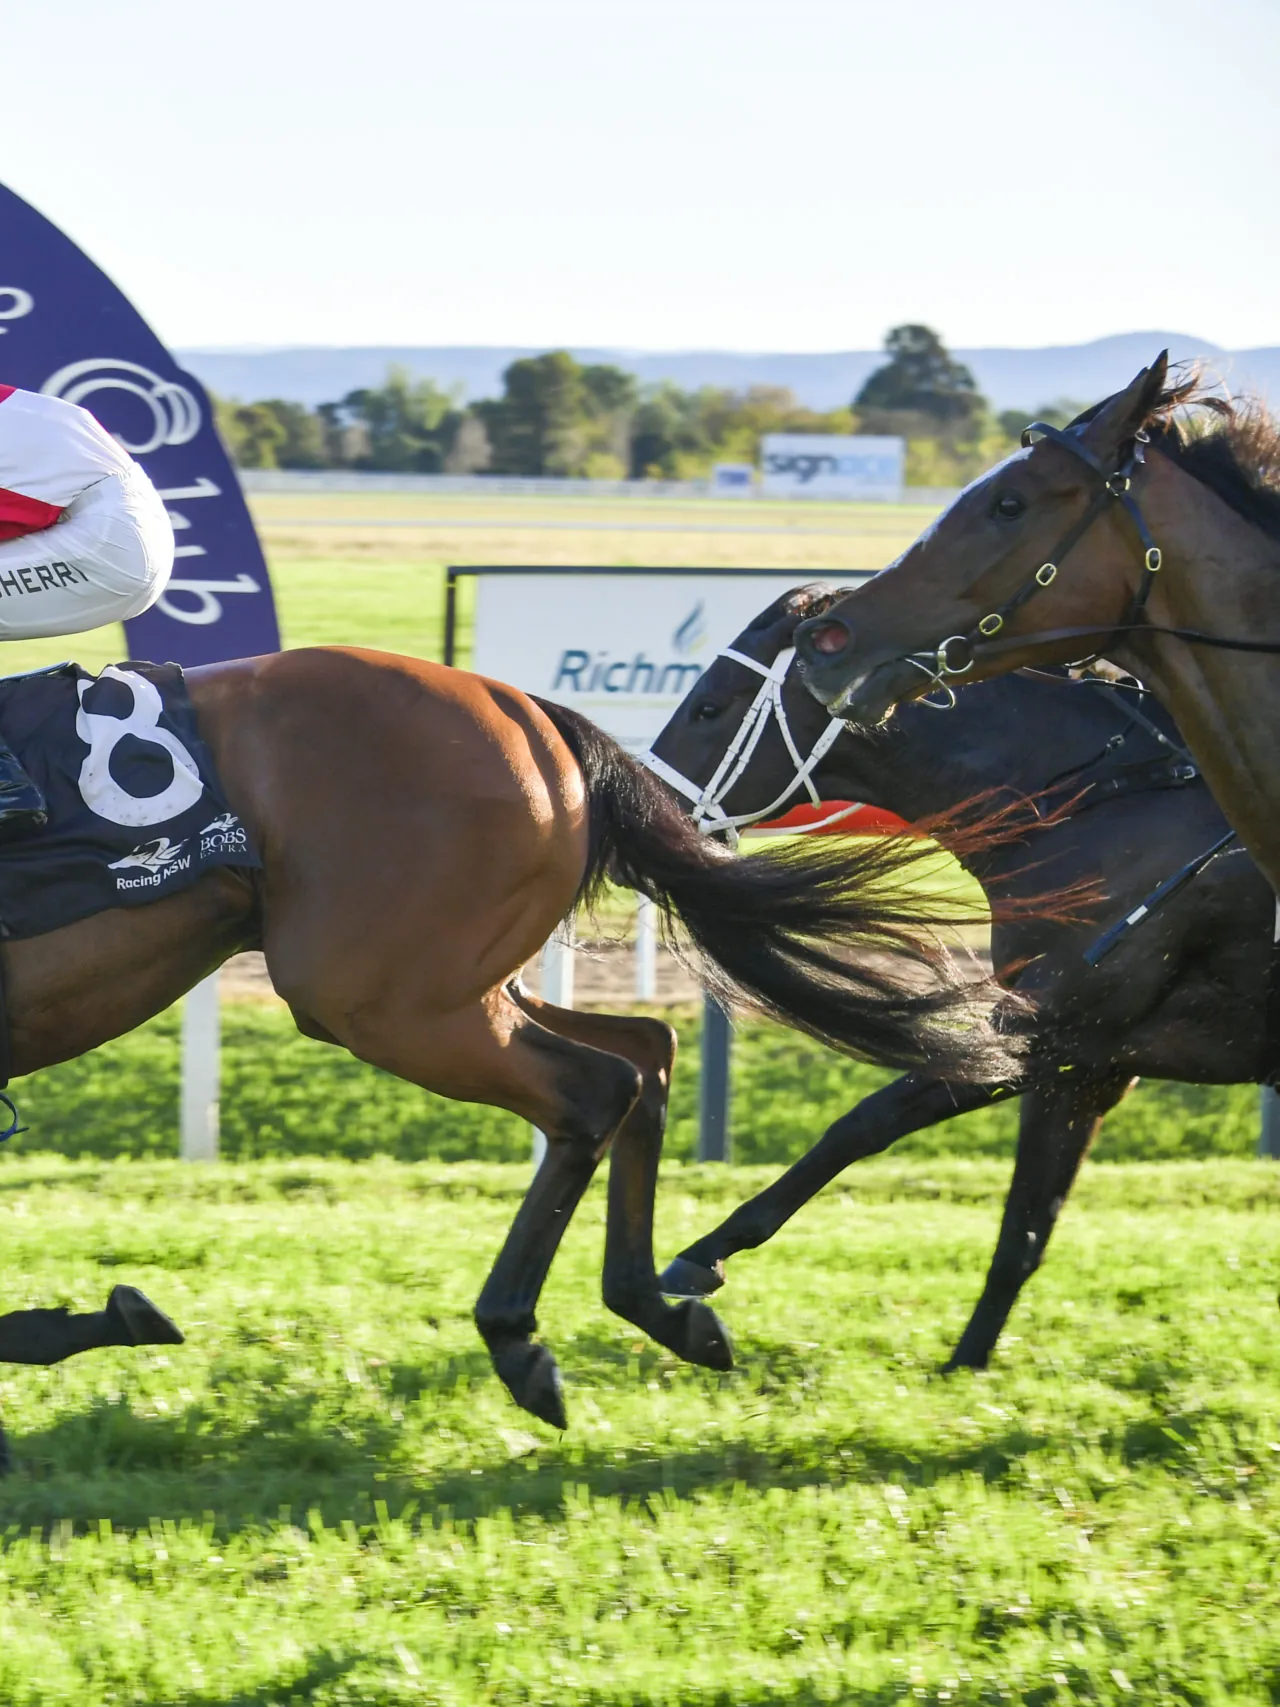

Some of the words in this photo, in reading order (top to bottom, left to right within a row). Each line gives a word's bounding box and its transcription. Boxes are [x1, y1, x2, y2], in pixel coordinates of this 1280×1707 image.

[76, 665, 204, 827] 8
[200, 828, 247, 851] BOBS
[116, 873, 161, 889] Racing
[163, 855, 191, 879] NSW
